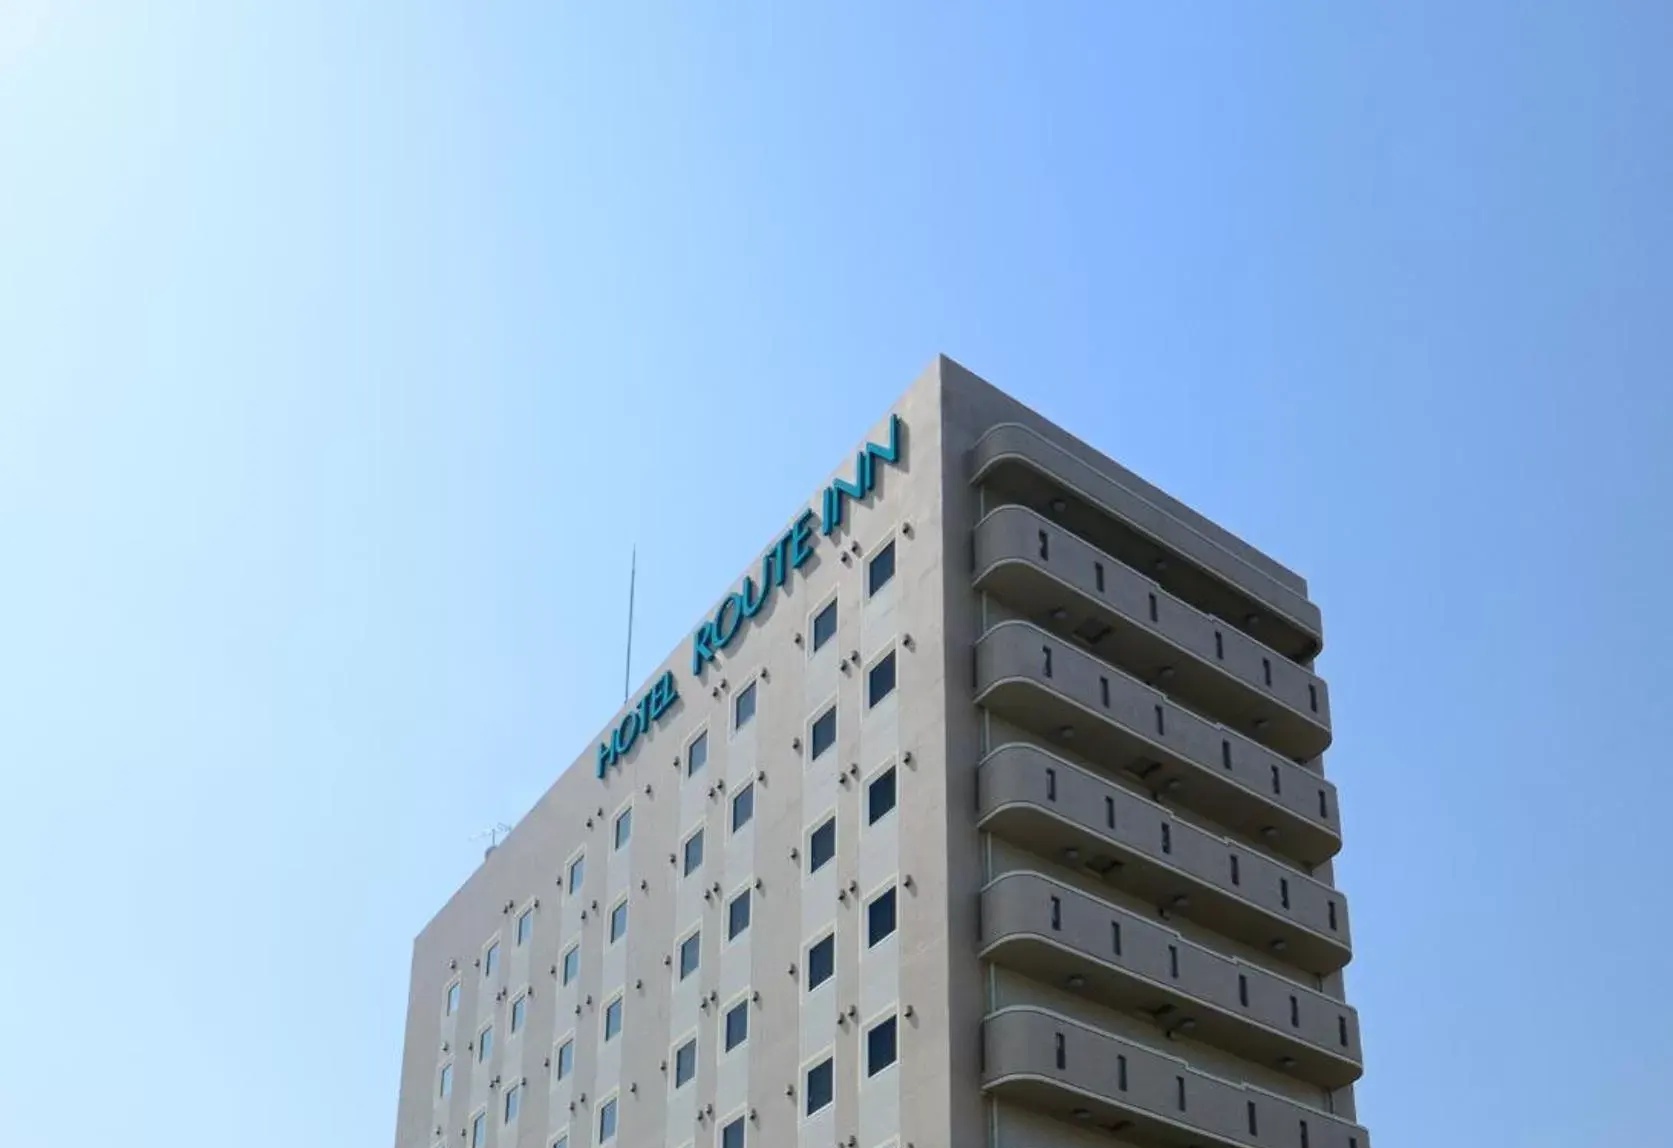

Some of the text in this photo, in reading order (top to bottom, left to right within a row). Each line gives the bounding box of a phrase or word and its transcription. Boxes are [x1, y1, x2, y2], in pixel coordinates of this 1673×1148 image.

[596, 414, 900, 779] HOTEL ROUTE INN
